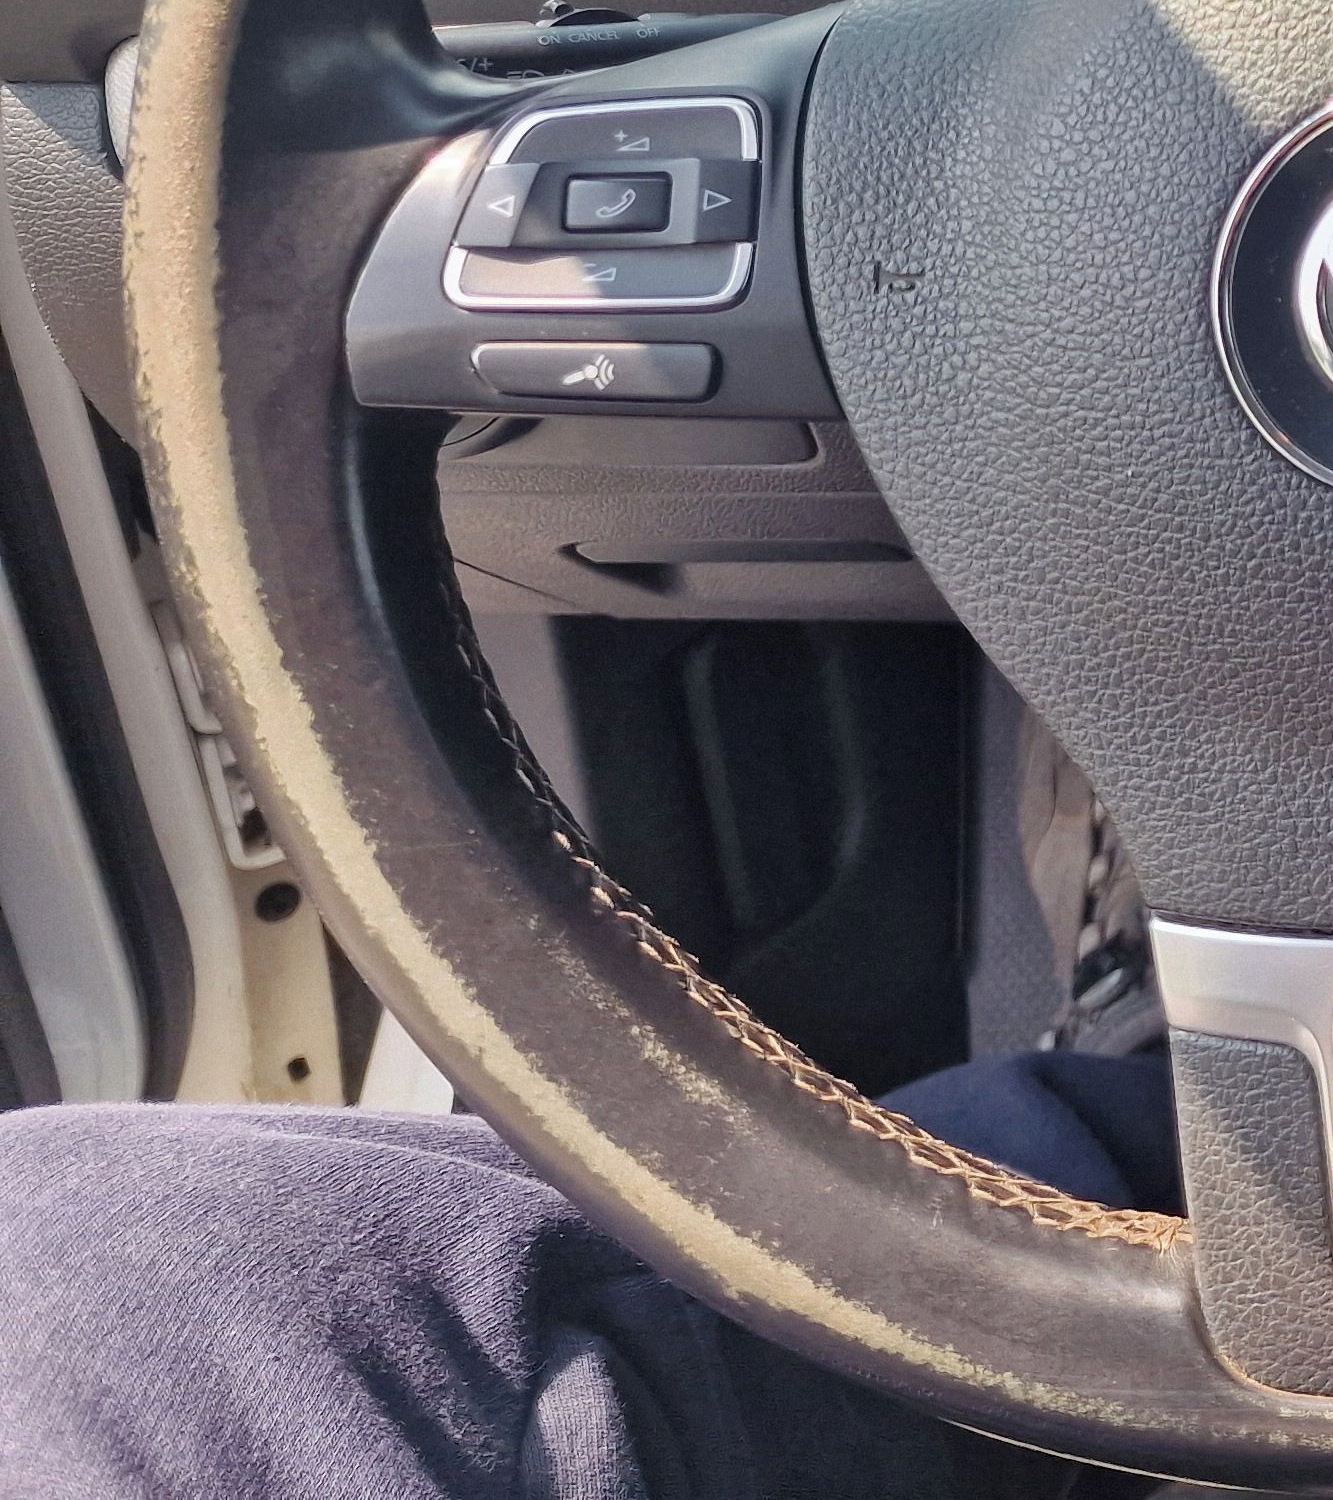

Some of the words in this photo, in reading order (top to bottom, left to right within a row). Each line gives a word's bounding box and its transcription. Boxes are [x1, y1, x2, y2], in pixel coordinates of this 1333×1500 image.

[537, 34, 560, 46] ON
[568, 30, 620, 43] CANCEL
[637, 28, 661, 38] OFF
